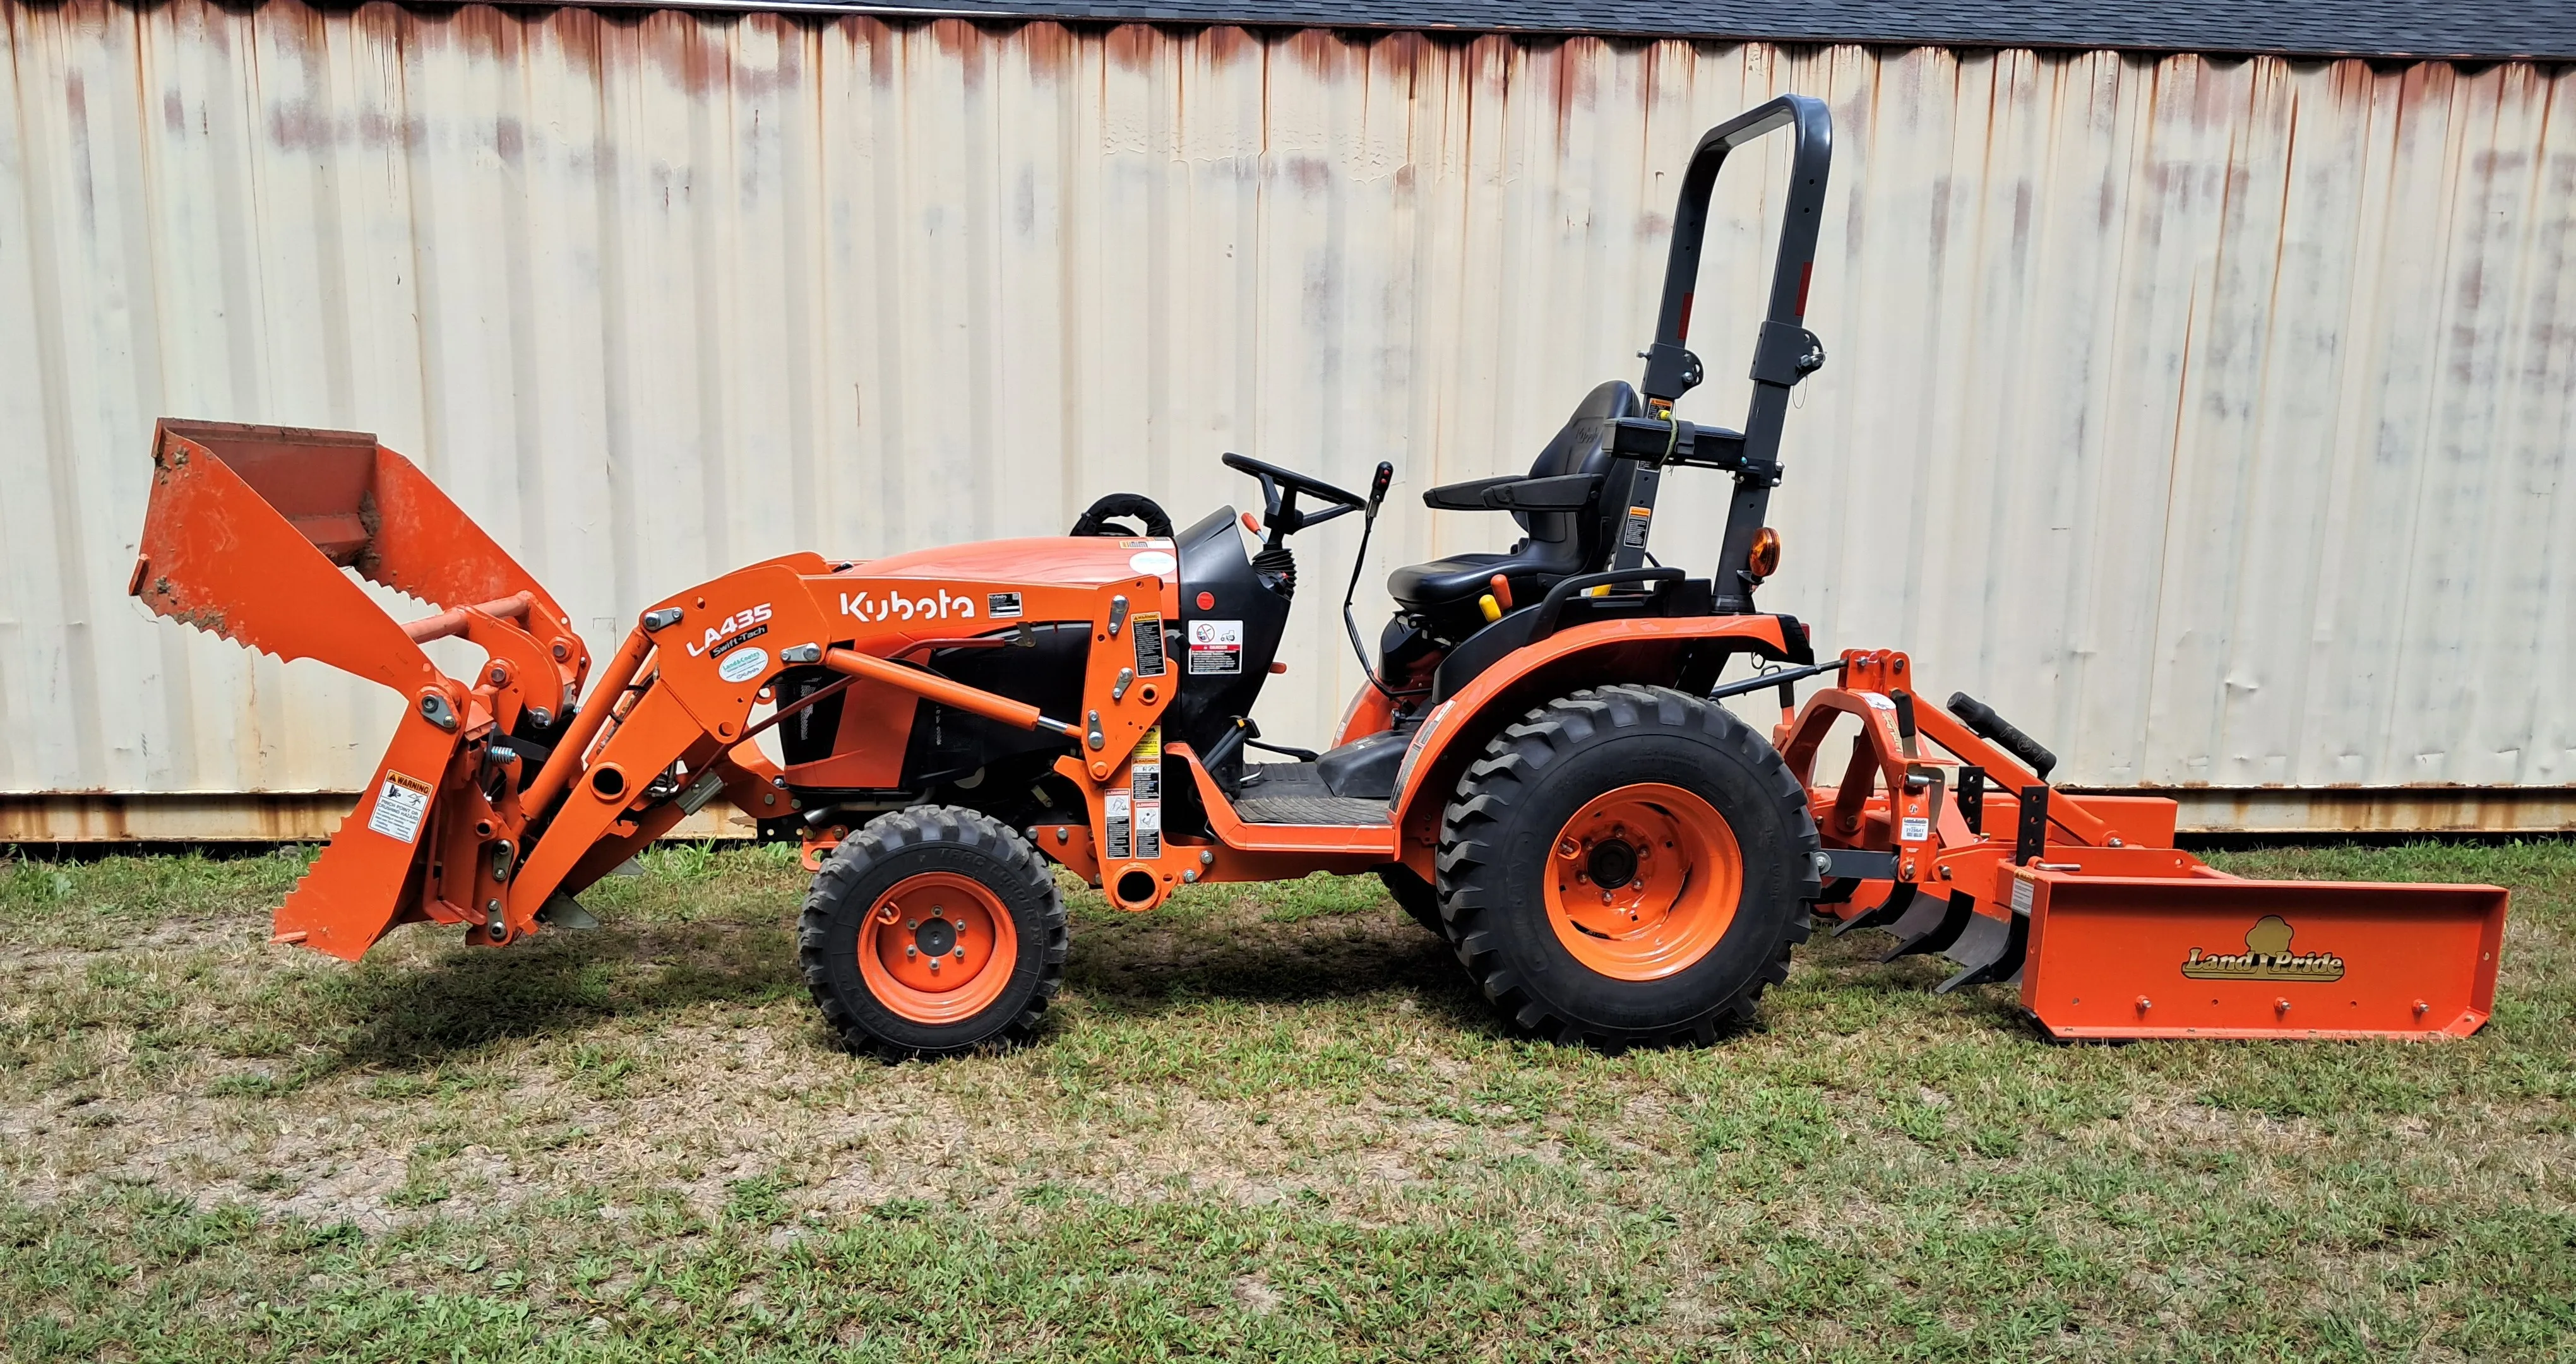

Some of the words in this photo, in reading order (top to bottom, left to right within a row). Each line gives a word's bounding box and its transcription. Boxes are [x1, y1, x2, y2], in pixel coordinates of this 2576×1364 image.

[839, 588, 975, 622] Kubota
[686, 602, 773, 657] LA435
[712, 626, 766, 657] Swift-Tach
[397, 775, 430, 794] WARNING
[397, 804, 411, 813] POINT
[400, 812, 419, 821] HAZARD
[2185, 947, 2257, 972] Land
[2270, 950, 2344, 975] Pride
